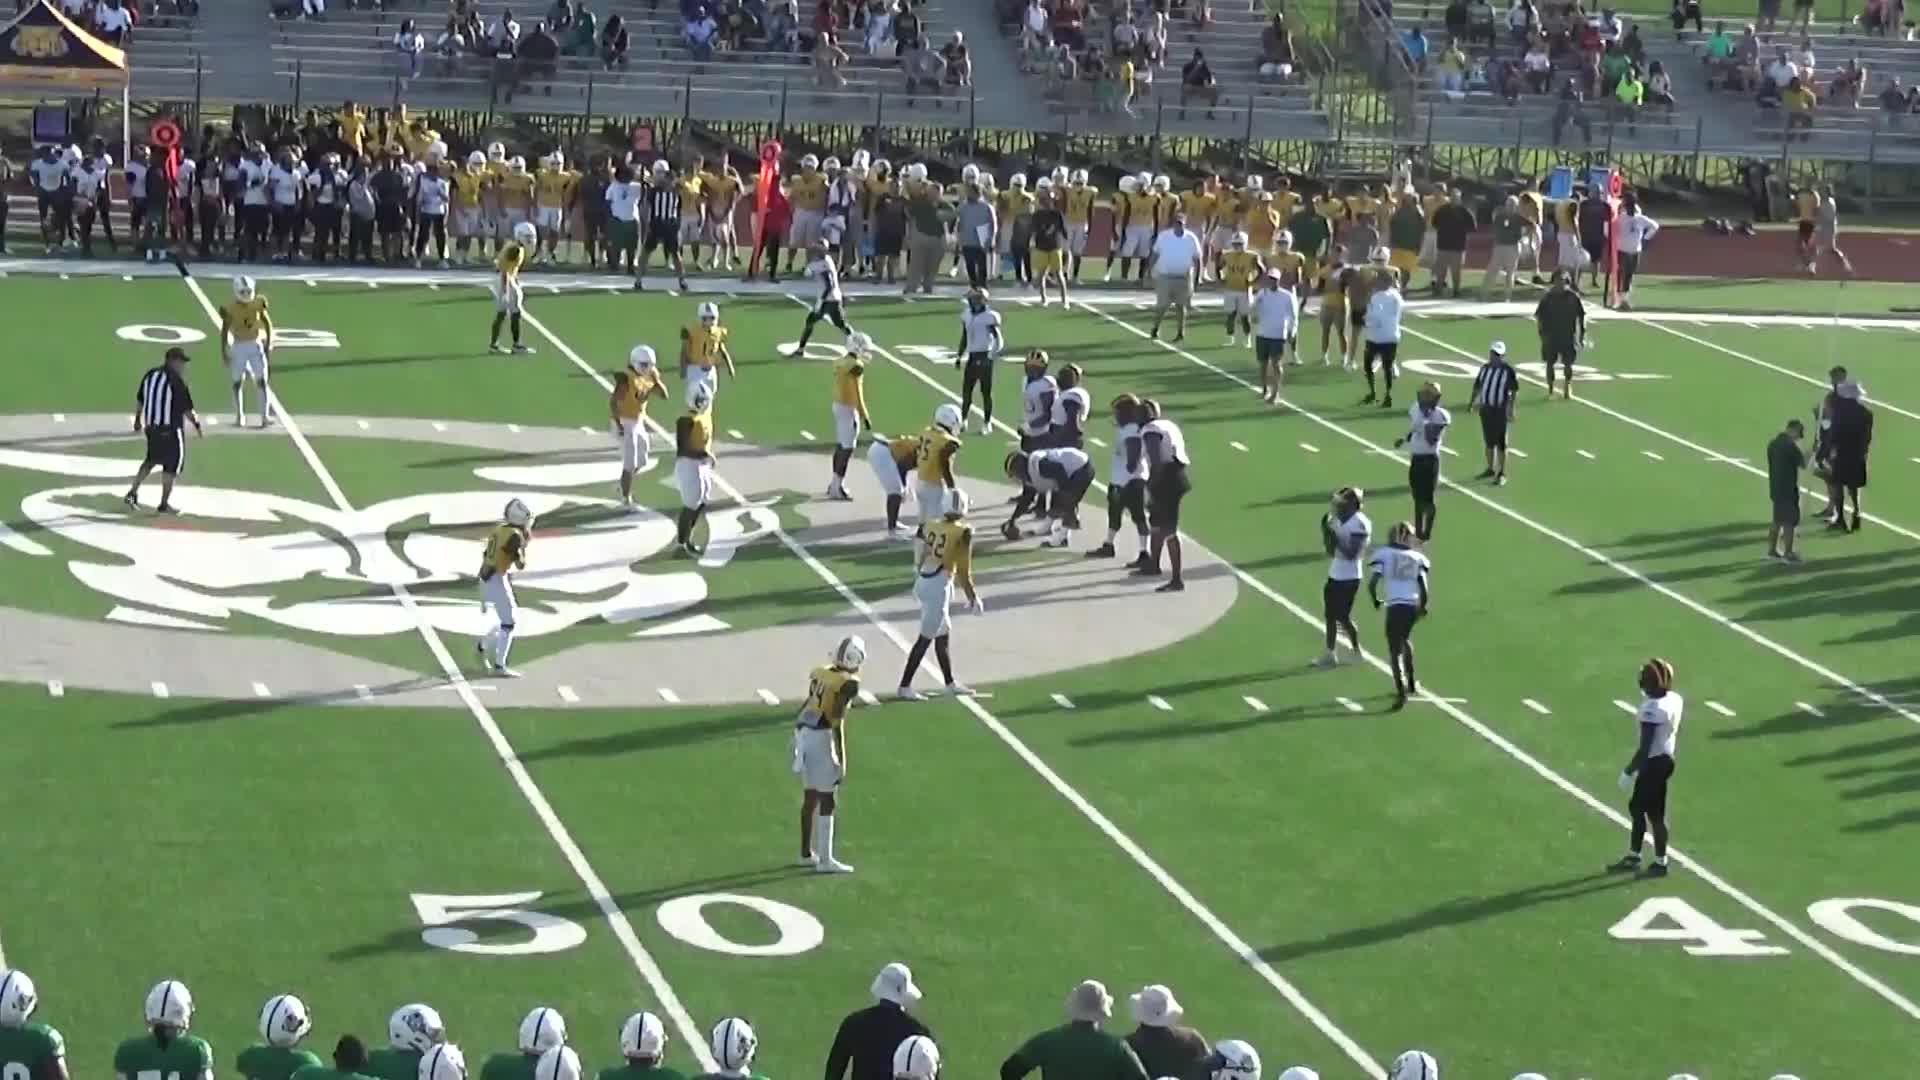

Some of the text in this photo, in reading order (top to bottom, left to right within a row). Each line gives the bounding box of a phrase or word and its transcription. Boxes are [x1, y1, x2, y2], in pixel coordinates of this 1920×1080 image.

[927, 530, 946, 559] 92
[409, 891, 825, 956] 50
[1607, 897, 1920, 955] 40
